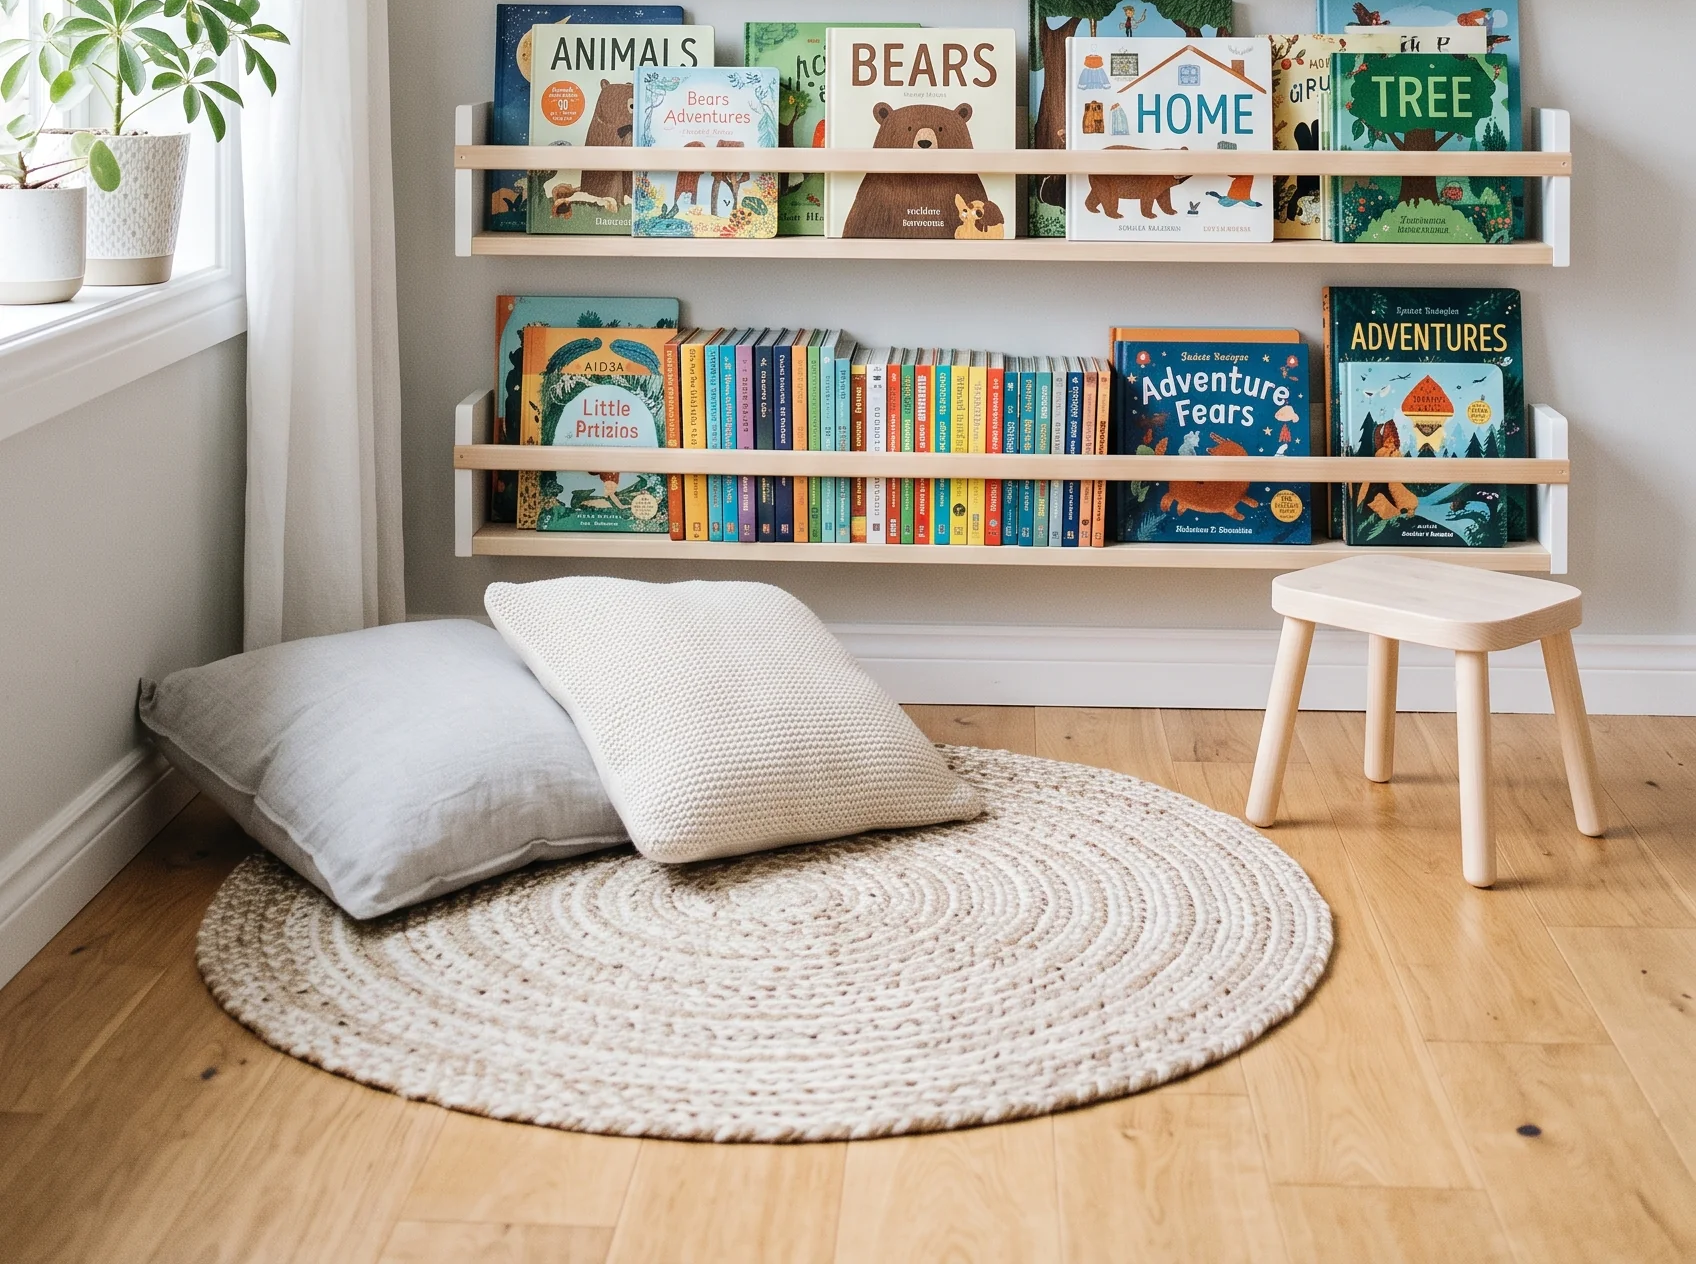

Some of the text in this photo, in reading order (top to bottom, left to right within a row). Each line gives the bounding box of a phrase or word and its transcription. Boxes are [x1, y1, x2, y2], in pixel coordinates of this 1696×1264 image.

[550, 37, 698, 71] ANIMALS
[852, 42, 998, 88] BEARS
[687, 91, 729, 106] Bears
[1371, 76, 1473, 118] TREE
[664, 109, 751, 125] Adventures
[1137, 93, 1254, 134] HOME
[1351, 322, 1508, 352] ADVENTURES
[1142, 366, 1290, 406] Adventure
[583, 398, 631, 416] Little
[1175, 399, 1254, 427] Fears
